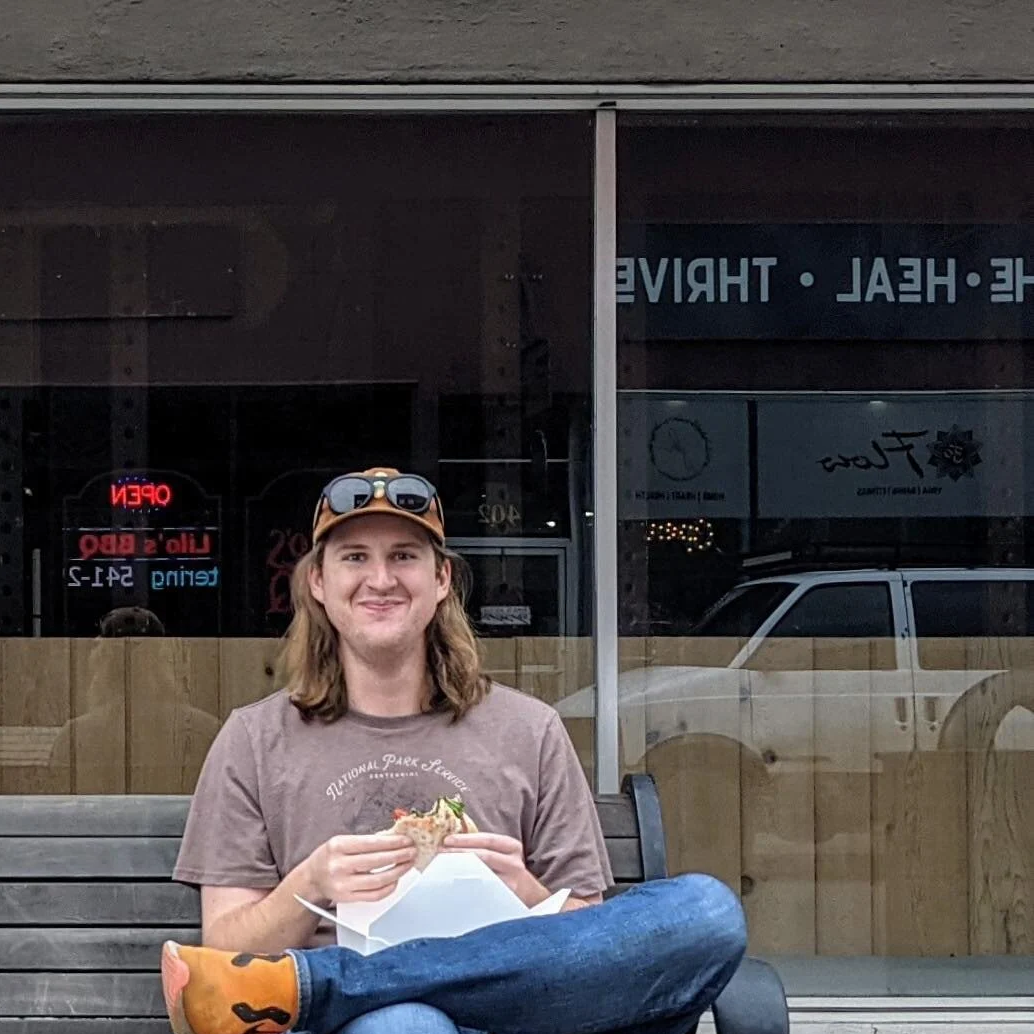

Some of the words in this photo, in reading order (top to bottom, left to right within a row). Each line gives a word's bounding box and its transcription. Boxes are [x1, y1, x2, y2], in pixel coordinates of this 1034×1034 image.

[326, 760, 380, 800] NATIONAL
[382, 753, 420, 771] PARK
[421, 758, 471, 793] SERVICE
